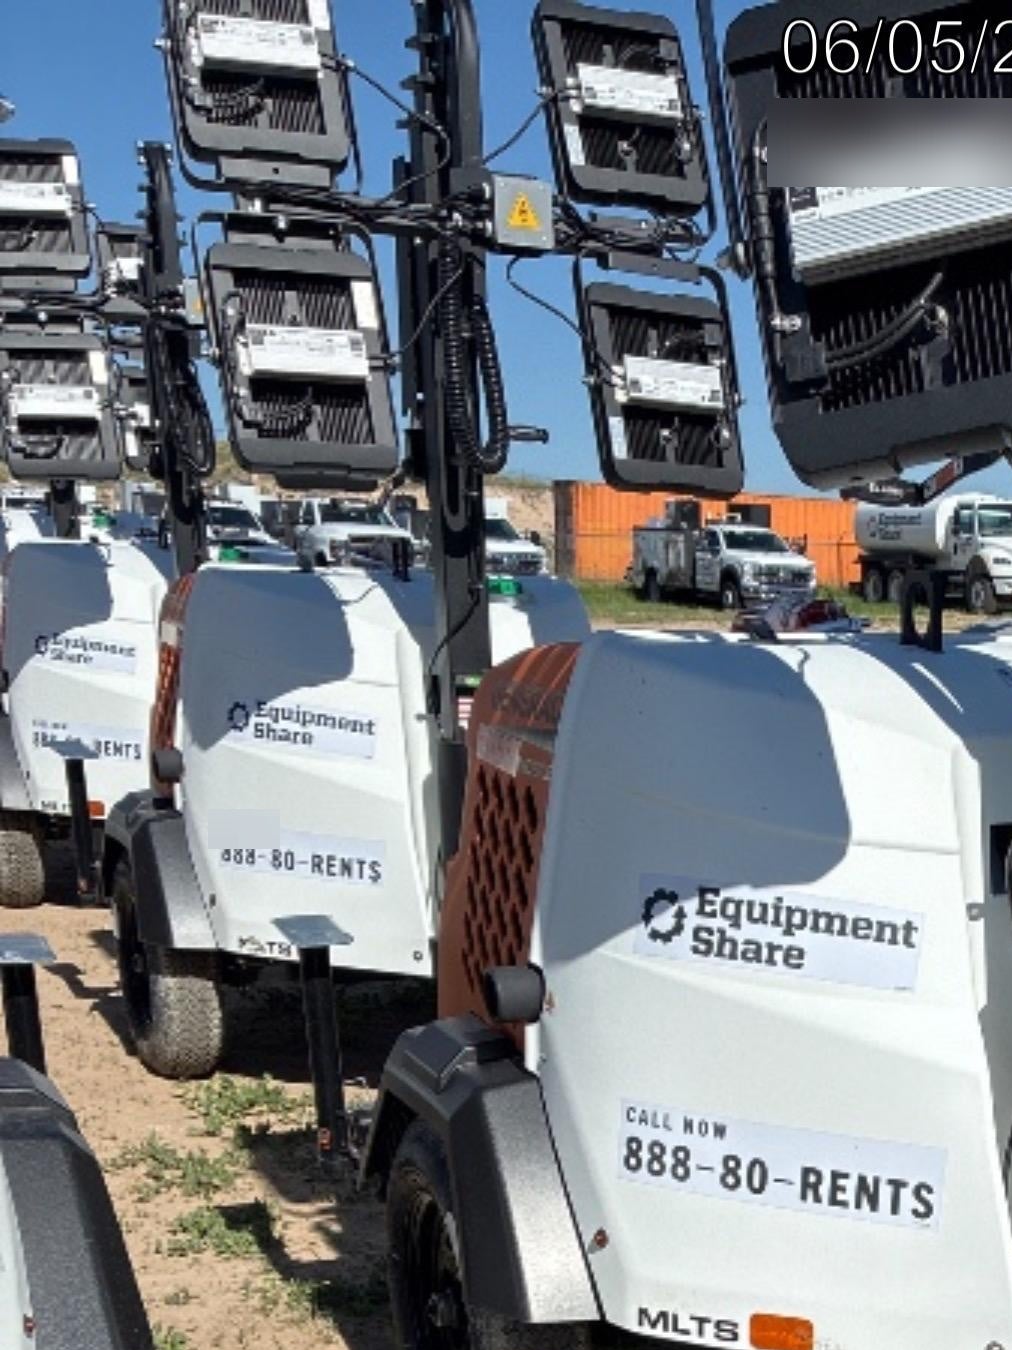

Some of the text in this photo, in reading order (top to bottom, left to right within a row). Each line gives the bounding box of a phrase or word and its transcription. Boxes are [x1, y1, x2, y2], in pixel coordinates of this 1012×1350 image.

[253, 721, 313, 745] Share
[254, 700, 376, 736] Equipment
[695, 886, 920, 949] Equipment
[690, 926, 807, 970] Share
[625, 1105, 728, 1141] CALL NOW
[623, 1135, 936, 1221] 888-80-RENTS
[637, 1306, 740, 1343] MLTS
